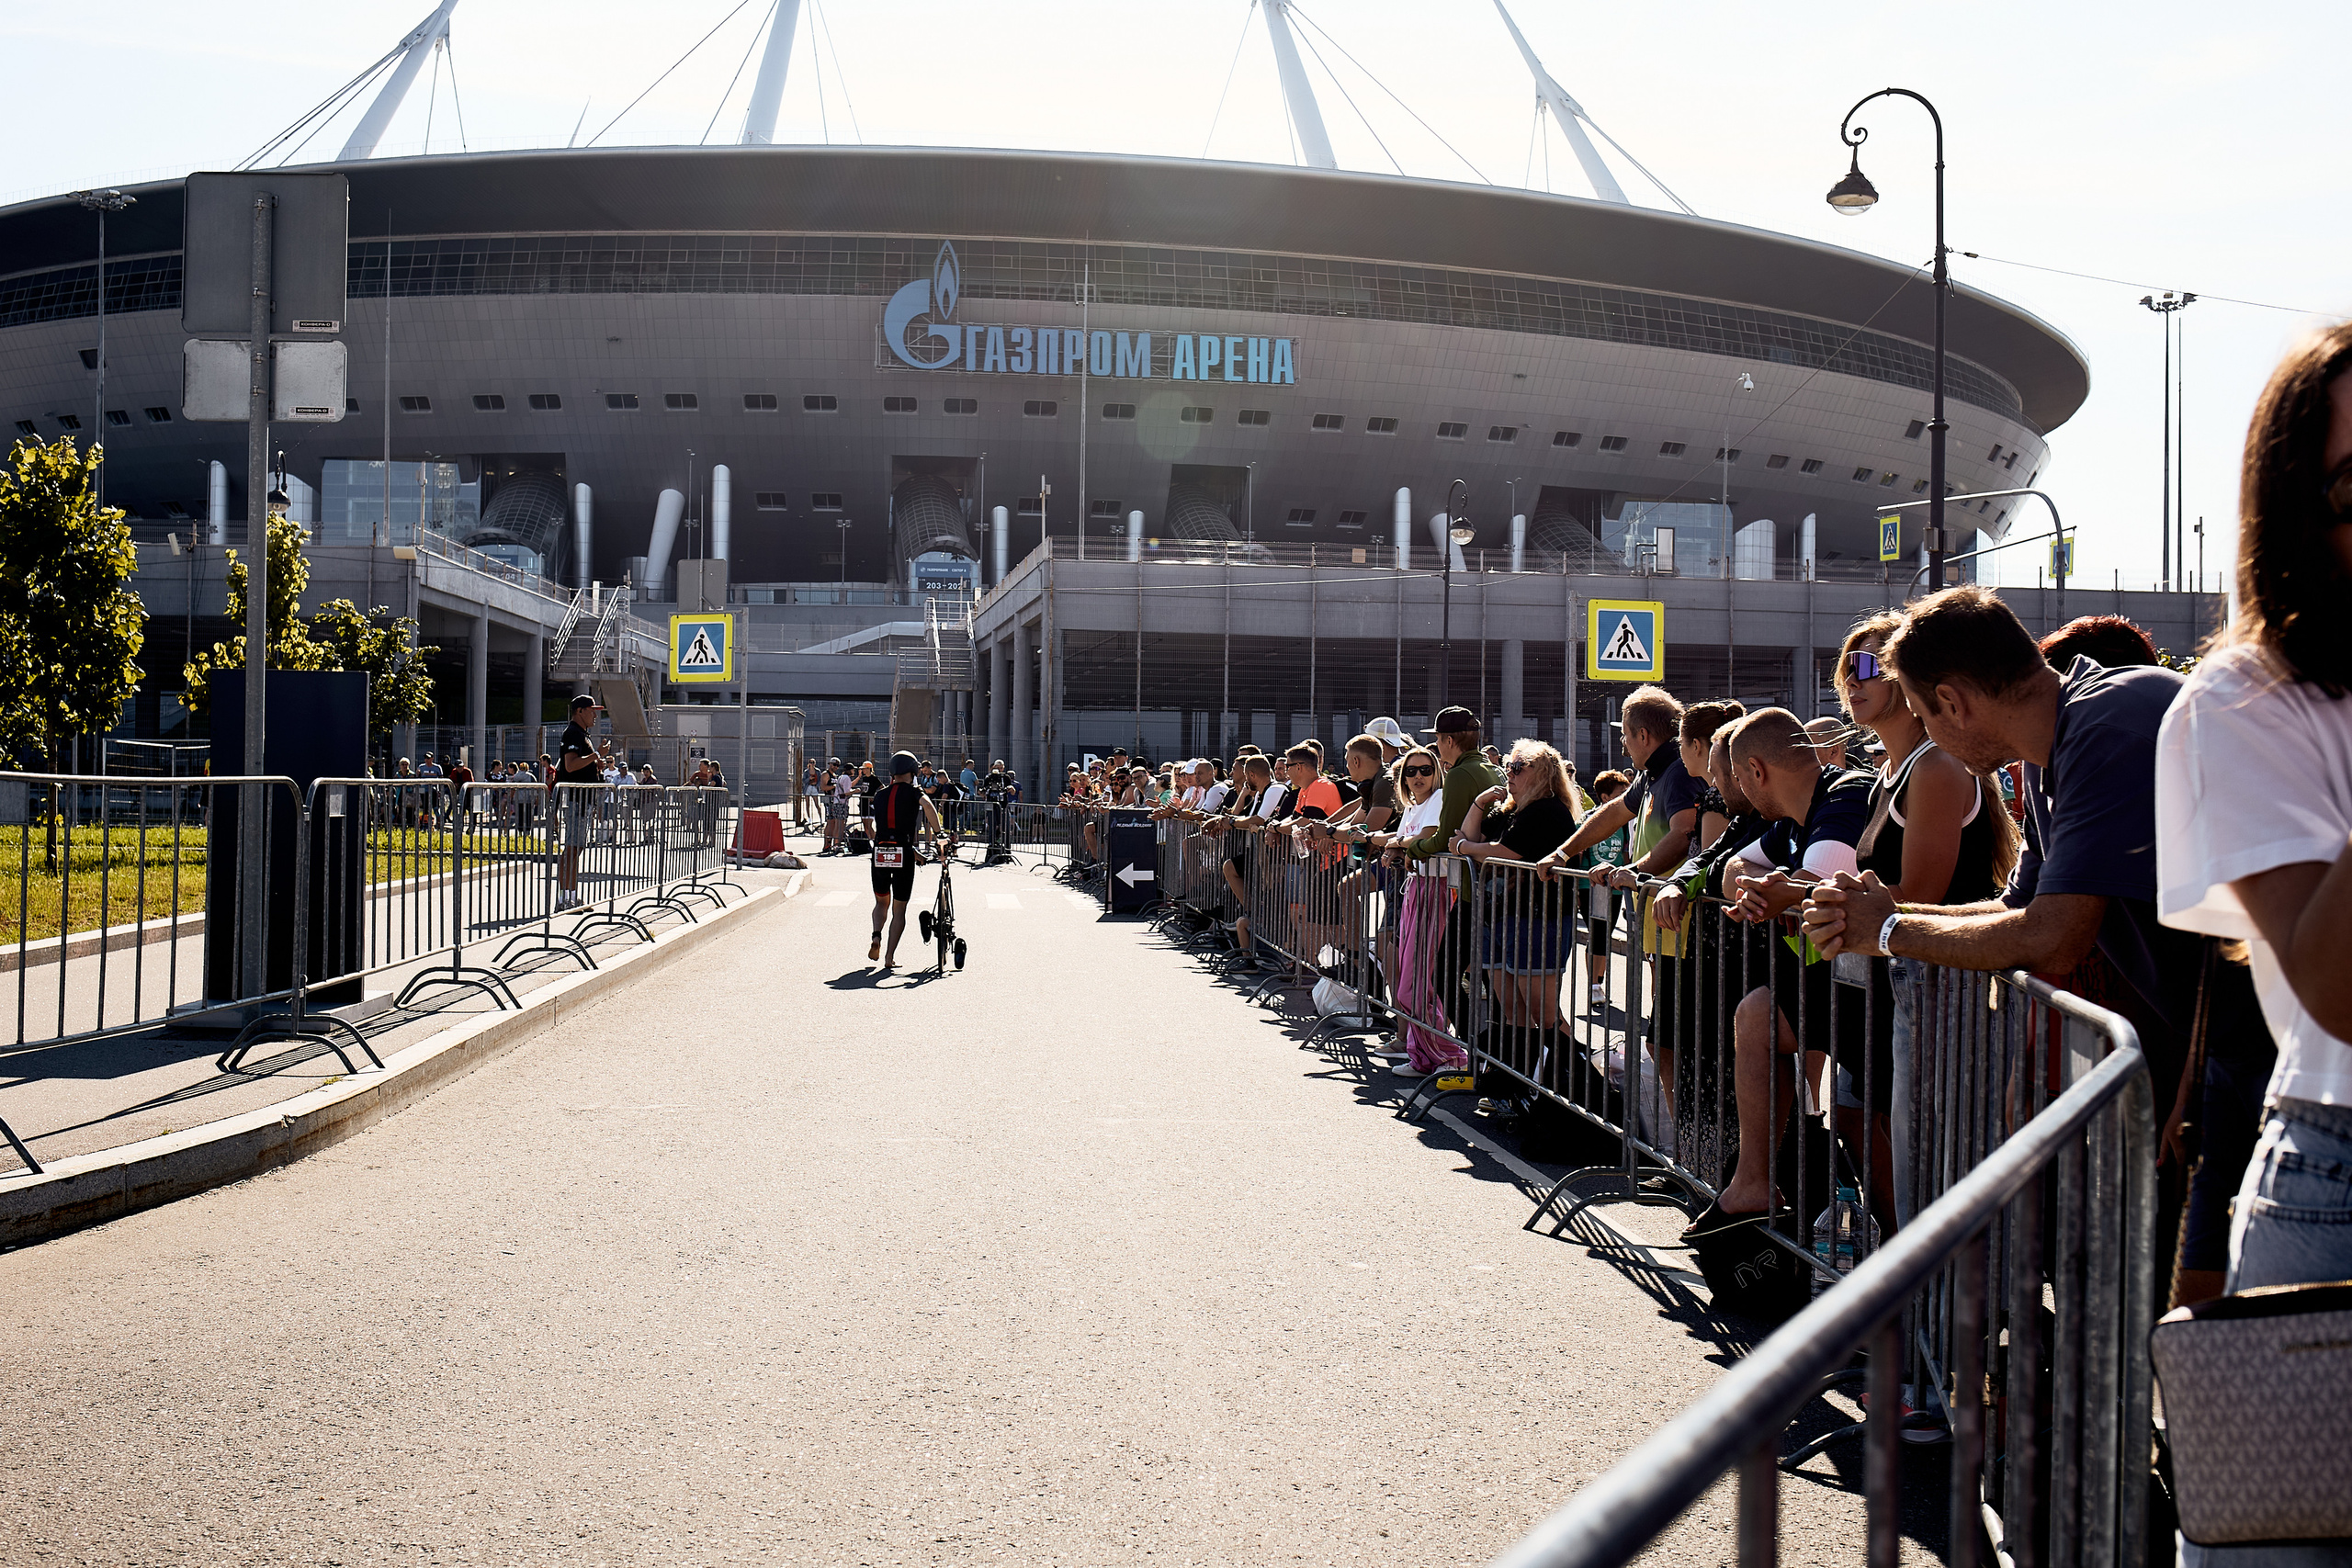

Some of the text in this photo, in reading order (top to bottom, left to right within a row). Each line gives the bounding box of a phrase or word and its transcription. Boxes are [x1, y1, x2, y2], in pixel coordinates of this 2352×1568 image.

[966, 325, 1295, 384] ГАЗПРОМ АРЕНА
[1734, 1248, 1780, 1289] TYR
